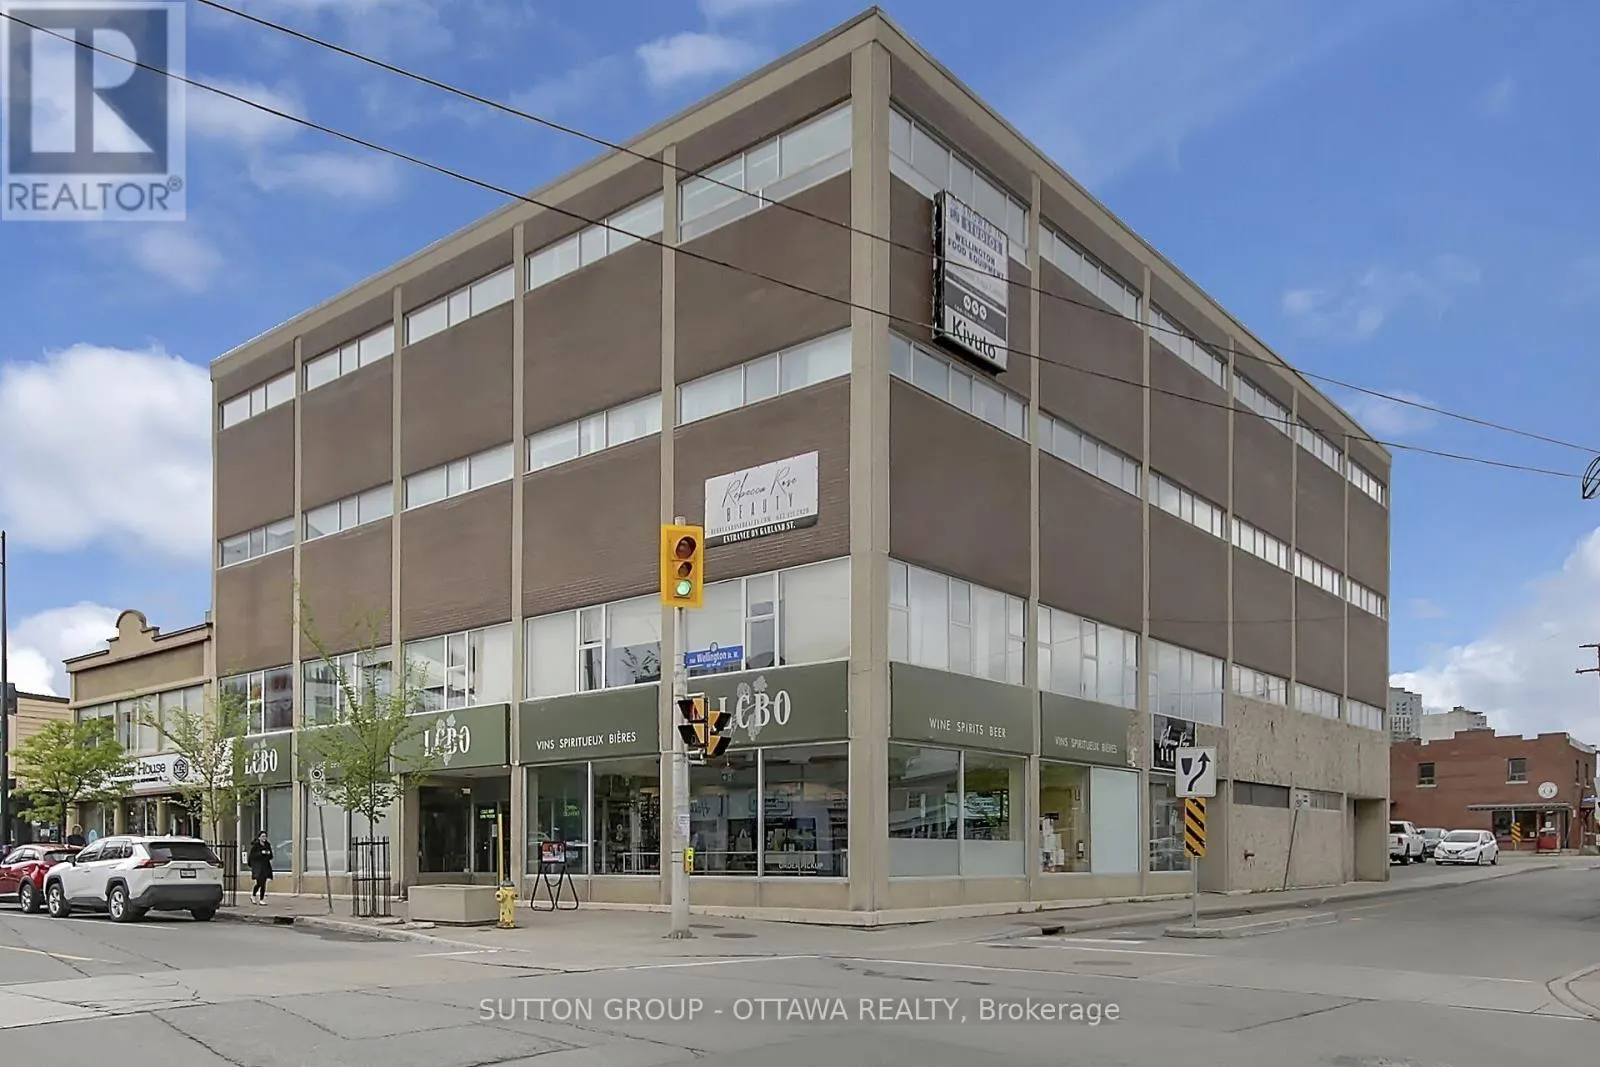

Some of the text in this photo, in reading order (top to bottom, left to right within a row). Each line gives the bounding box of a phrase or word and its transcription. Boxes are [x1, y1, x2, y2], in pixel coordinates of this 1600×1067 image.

[948, 238, 1004, 279] FOOD EQUIPMENT
[955, 232, 995, 266] WELLINGTON
[952, 316, 996, 359] Kivuto
[726, 492, 794, 522] BEAUTY
[723, 530, 750, 544] ENTRANCE
[786, 521, 796, 530] ST.
[697, 651, 727, 663] Wellington
[718, 690, 791, 730] LCBO
[424, 725, 471, 757] LCBO
[536, 730, 636, 750] VINS SPIRITUEUX BIÈRES
[929, 717, 1006, 738] WINE SPIRITS BEER
[137, 762, 166, 775] House
[244, 748, 278, 775] LCBO
